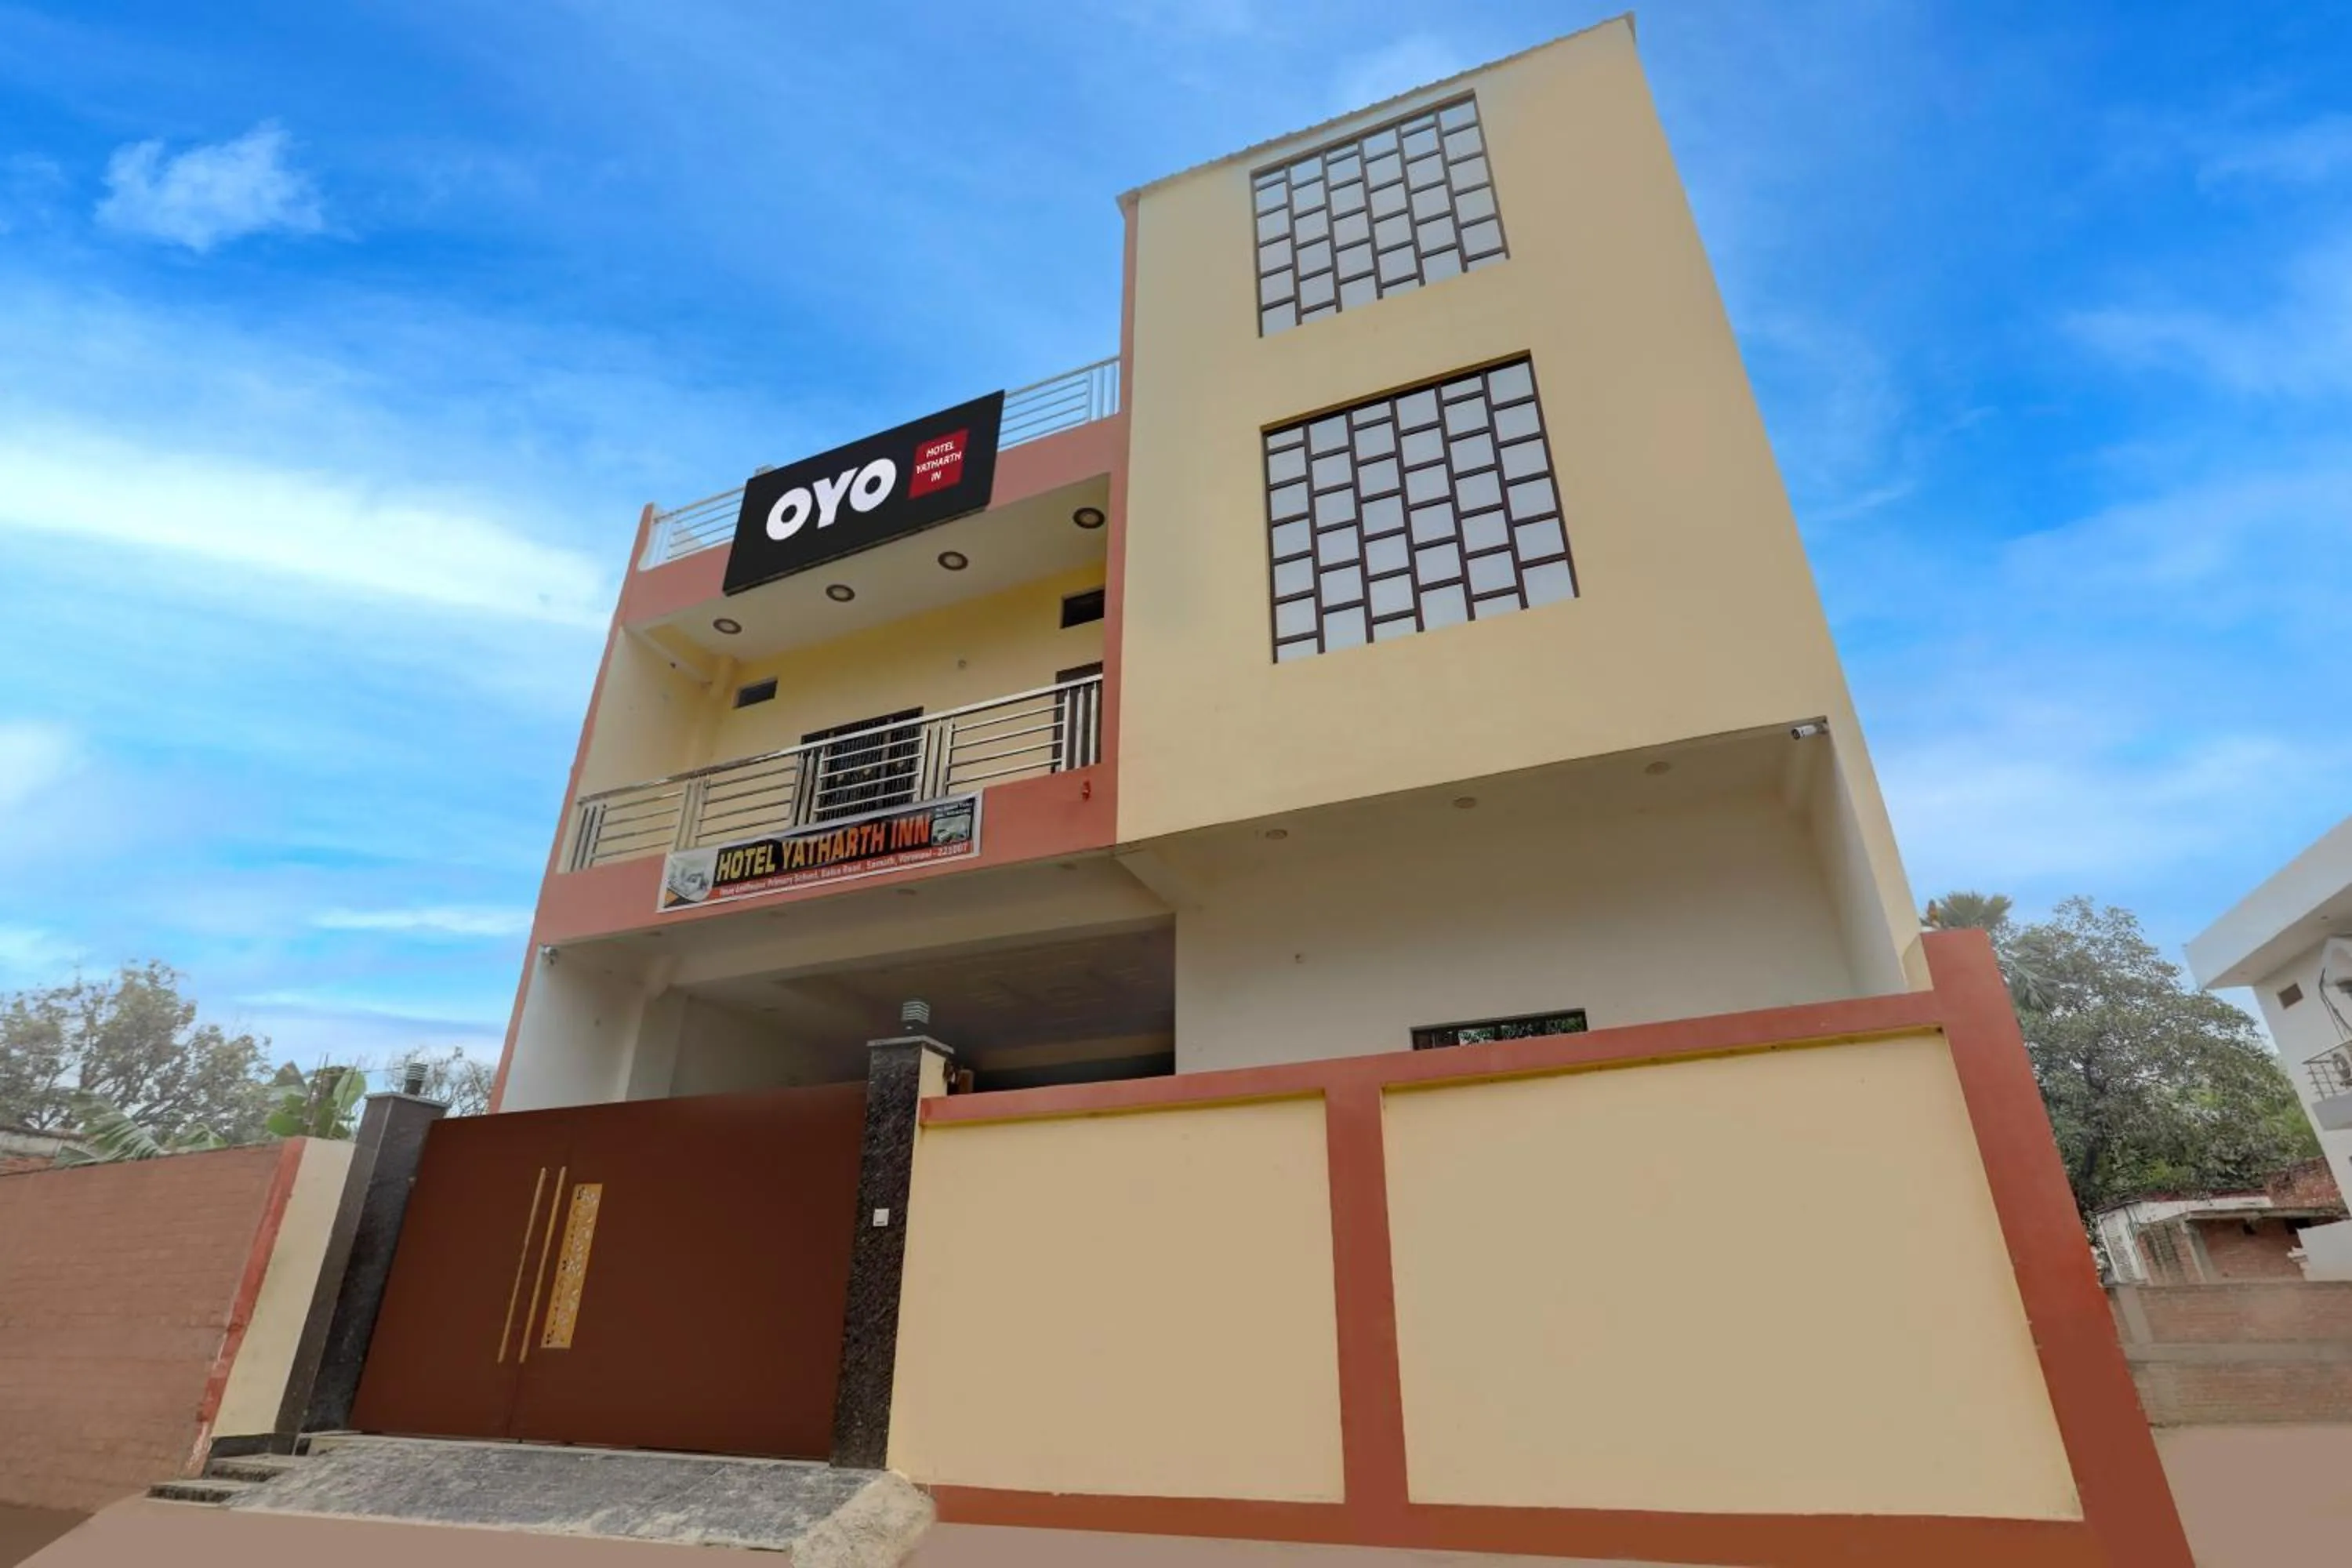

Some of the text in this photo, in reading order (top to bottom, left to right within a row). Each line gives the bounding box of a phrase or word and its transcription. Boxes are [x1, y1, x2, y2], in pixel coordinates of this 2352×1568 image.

[926, 441, 954, 458] HOTEL
[916, 452, 962, 474] YATHARTH
[931, 470, 942, 482] IN
[766, 458, 897, 540] OYO
[717, 813, 931, 881] HOTEL YATHARTH INN
